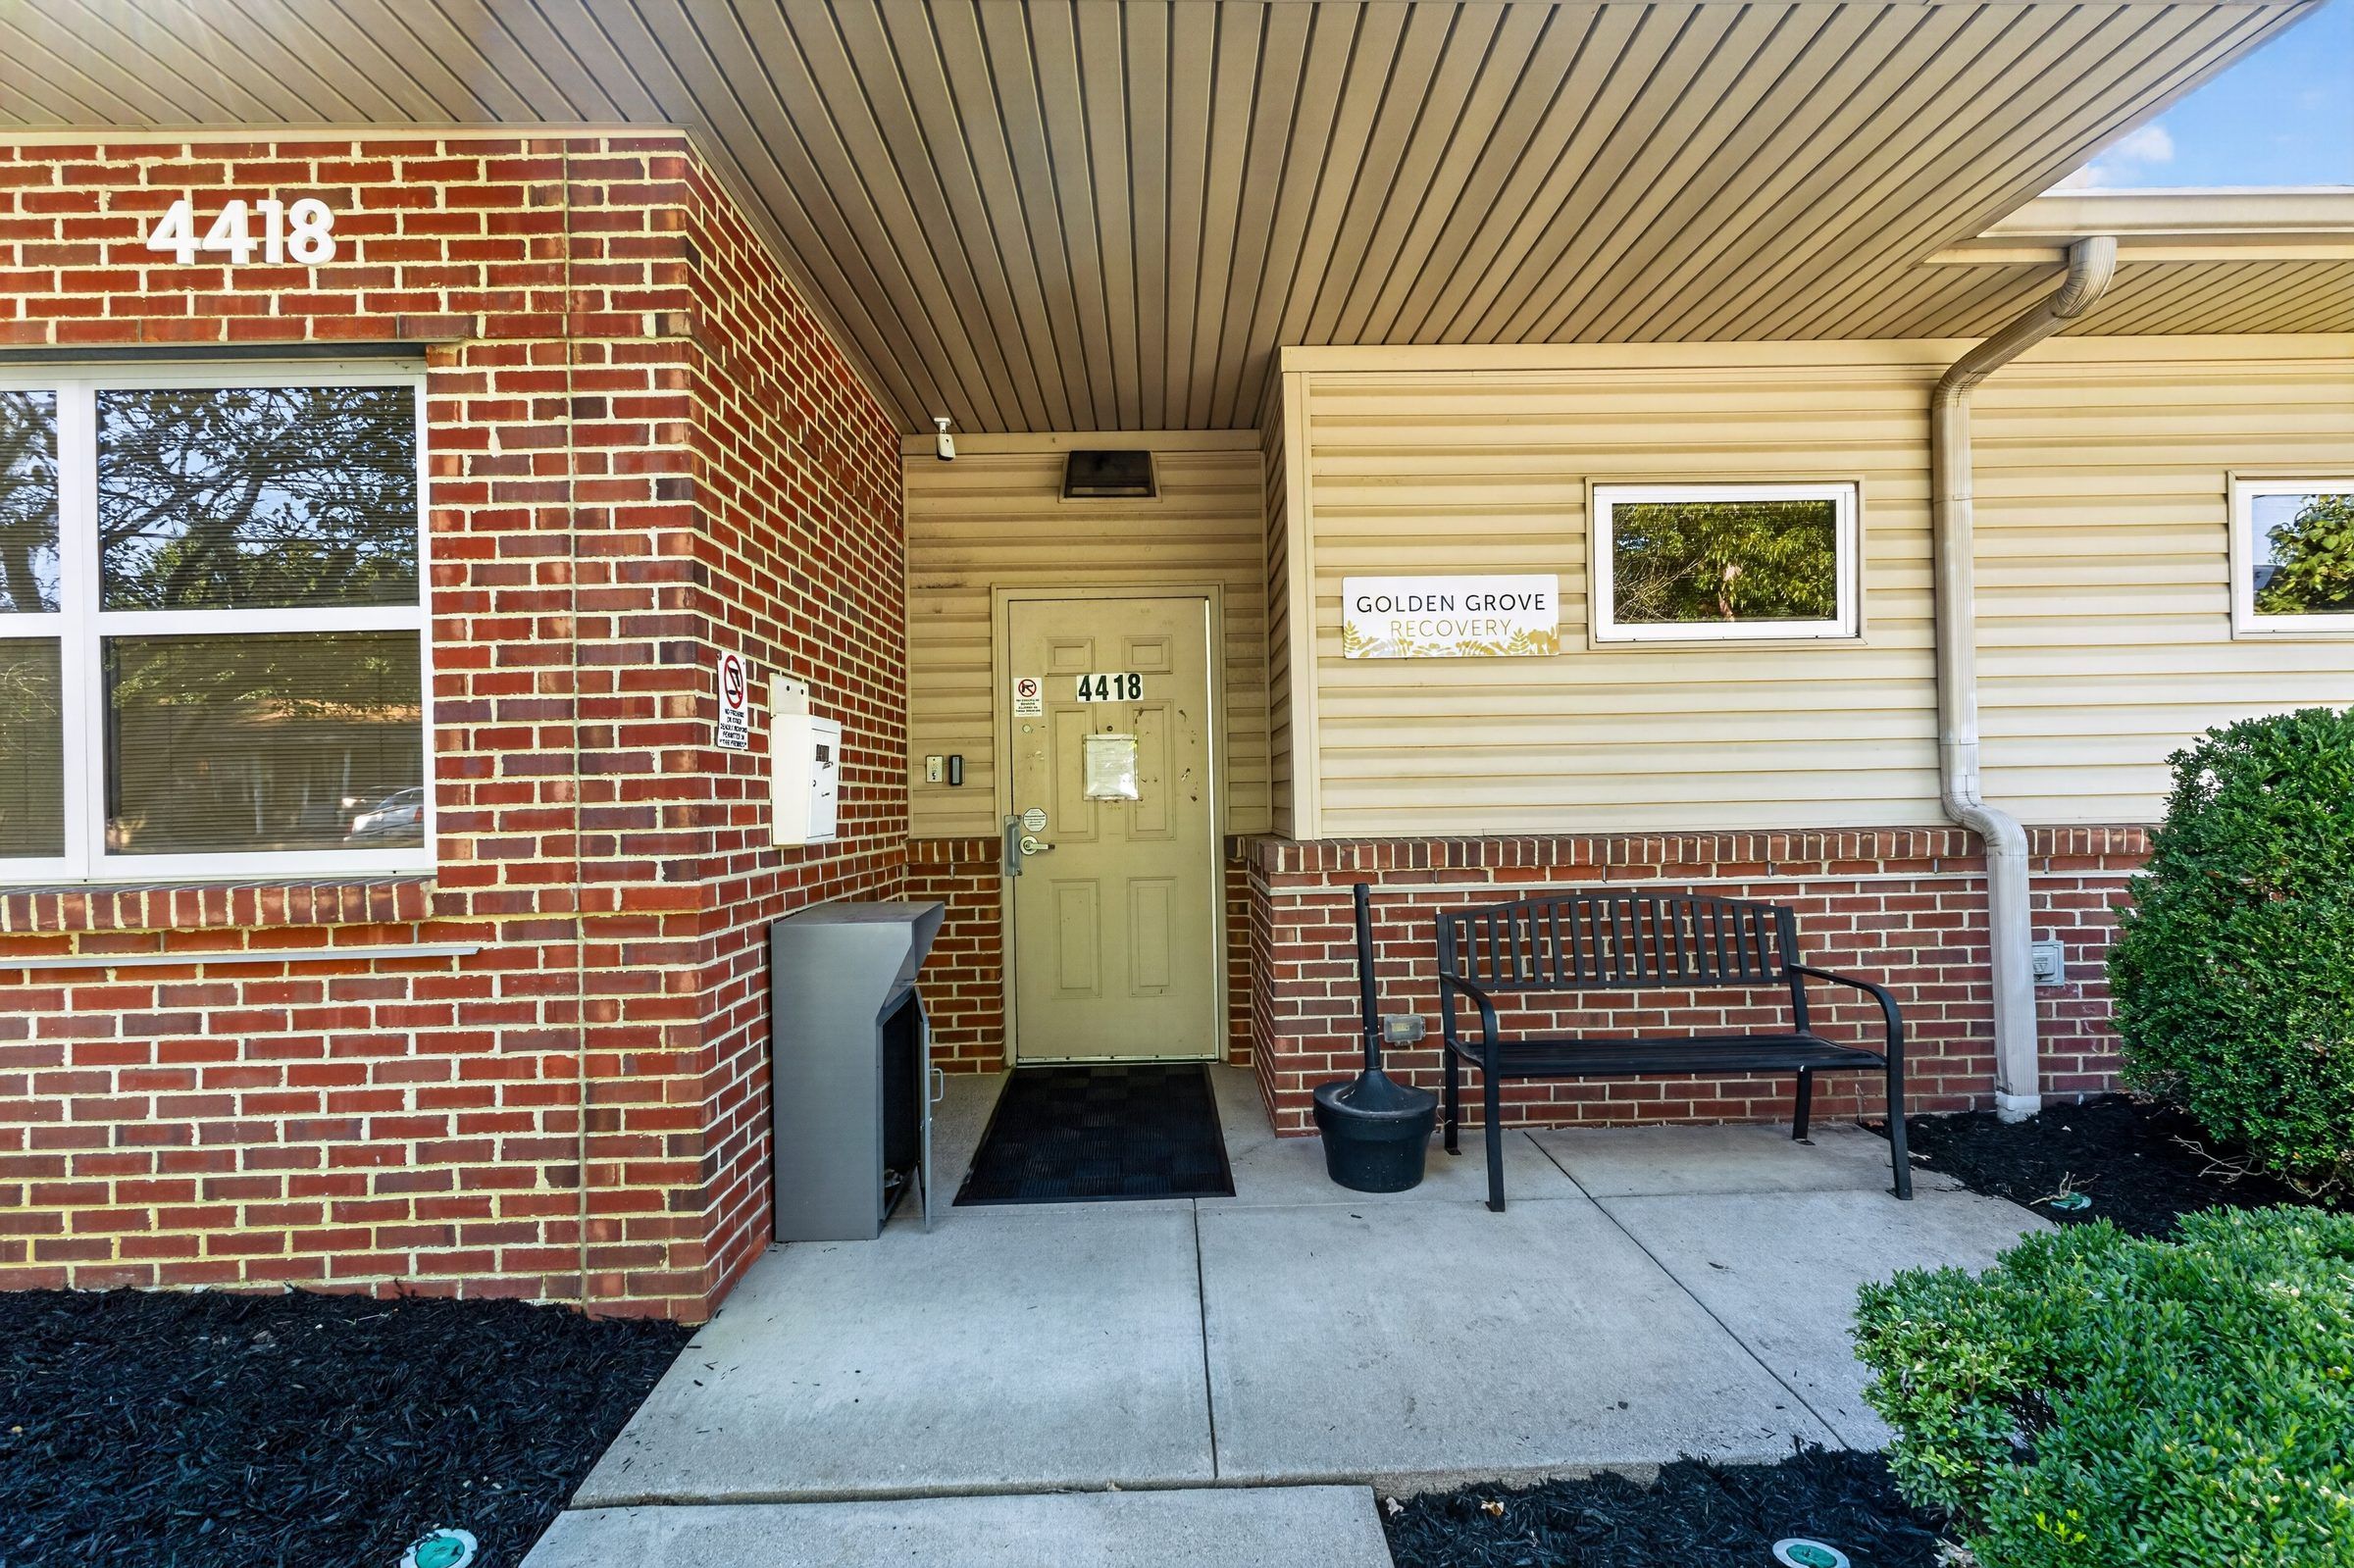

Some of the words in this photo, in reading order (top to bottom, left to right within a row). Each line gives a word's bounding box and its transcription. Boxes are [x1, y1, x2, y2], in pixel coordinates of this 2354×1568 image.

[146, 198, 336, 267] 4418
[1356, 594, 1455, 613] GOLDEN
[1465, 593, 1546, 612] GROVE
[1391, 619, 1511, 637] RECOVERY
[1078, 673, 1142, 702] 4418
